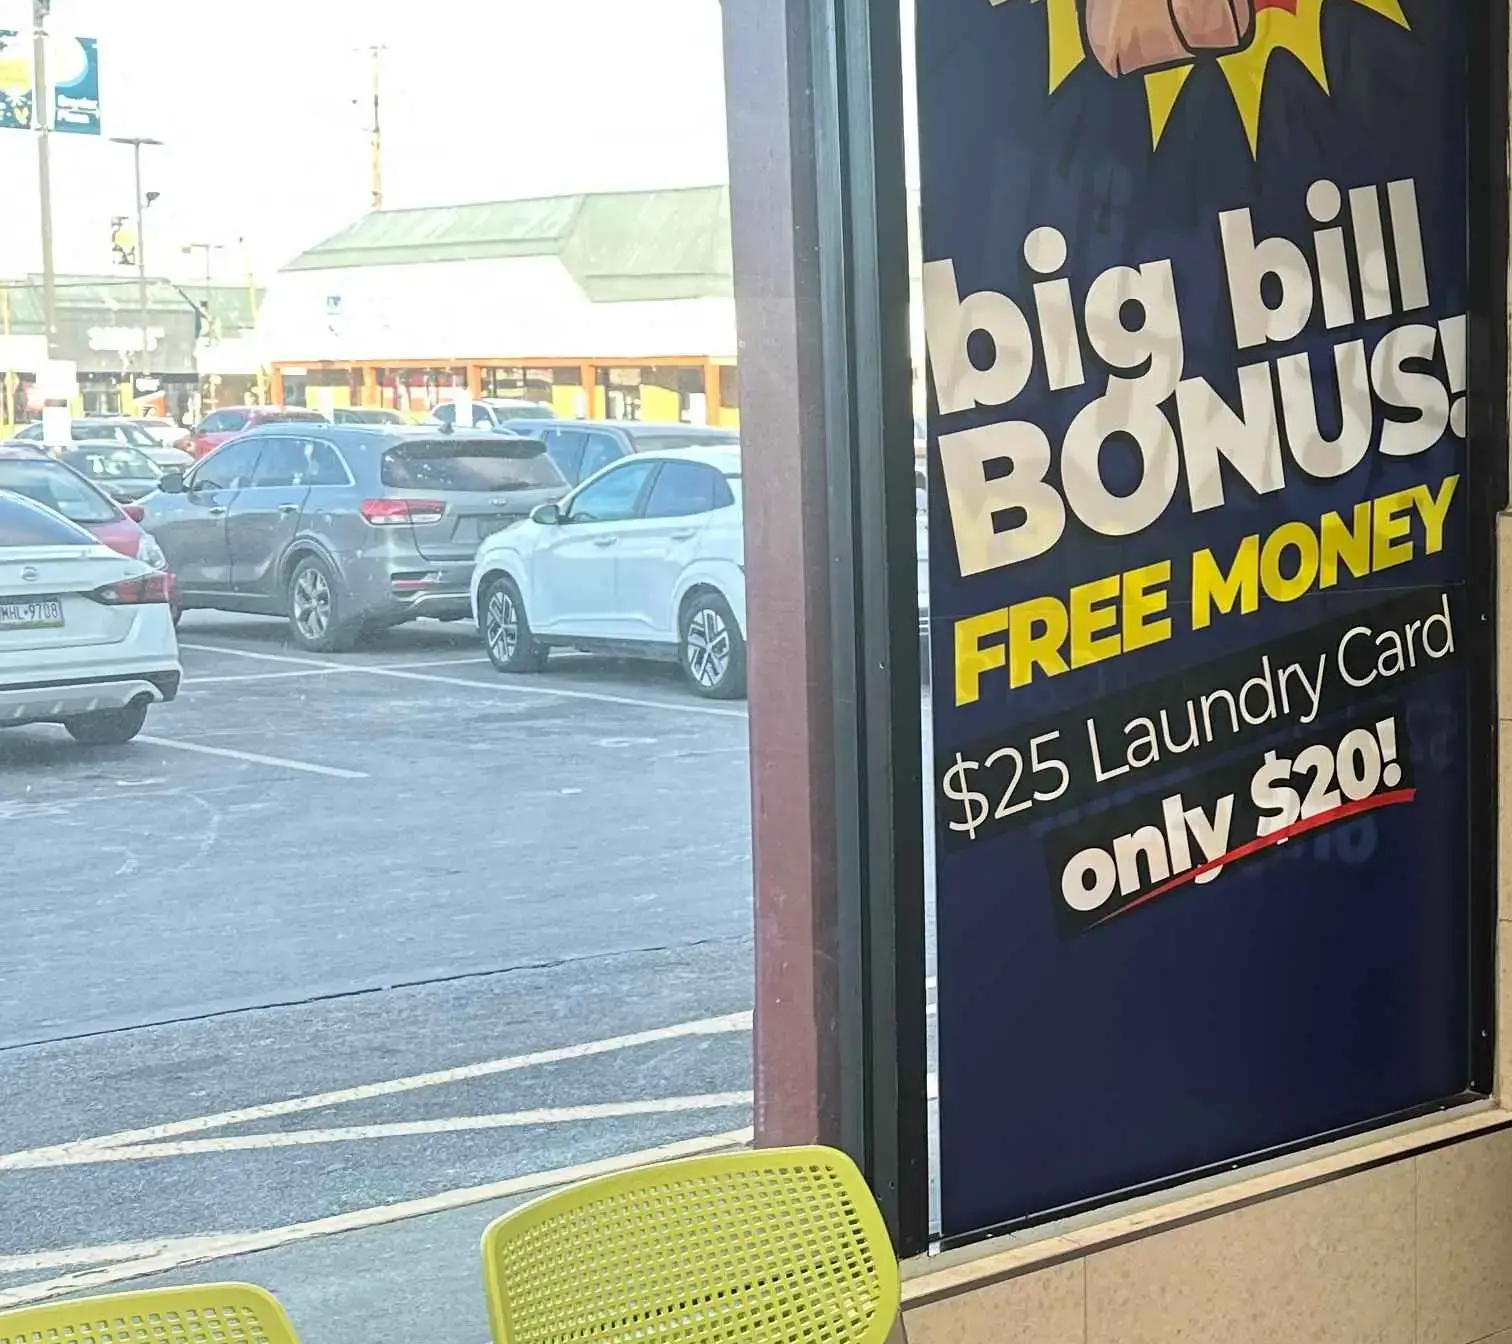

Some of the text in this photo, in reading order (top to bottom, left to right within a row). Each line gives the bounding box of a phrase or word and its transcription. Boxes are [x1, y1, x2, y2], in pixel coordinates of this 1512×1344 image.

[923, 178, 1431, 418] big bill
[938, 312, 1467, 577] BONUS!
[953, 474, 1460, 707] FREE MONEY
[942, 593, 1455, 839] $25 Laundry Card
[1061, 716, 1405, 913] only $20!
